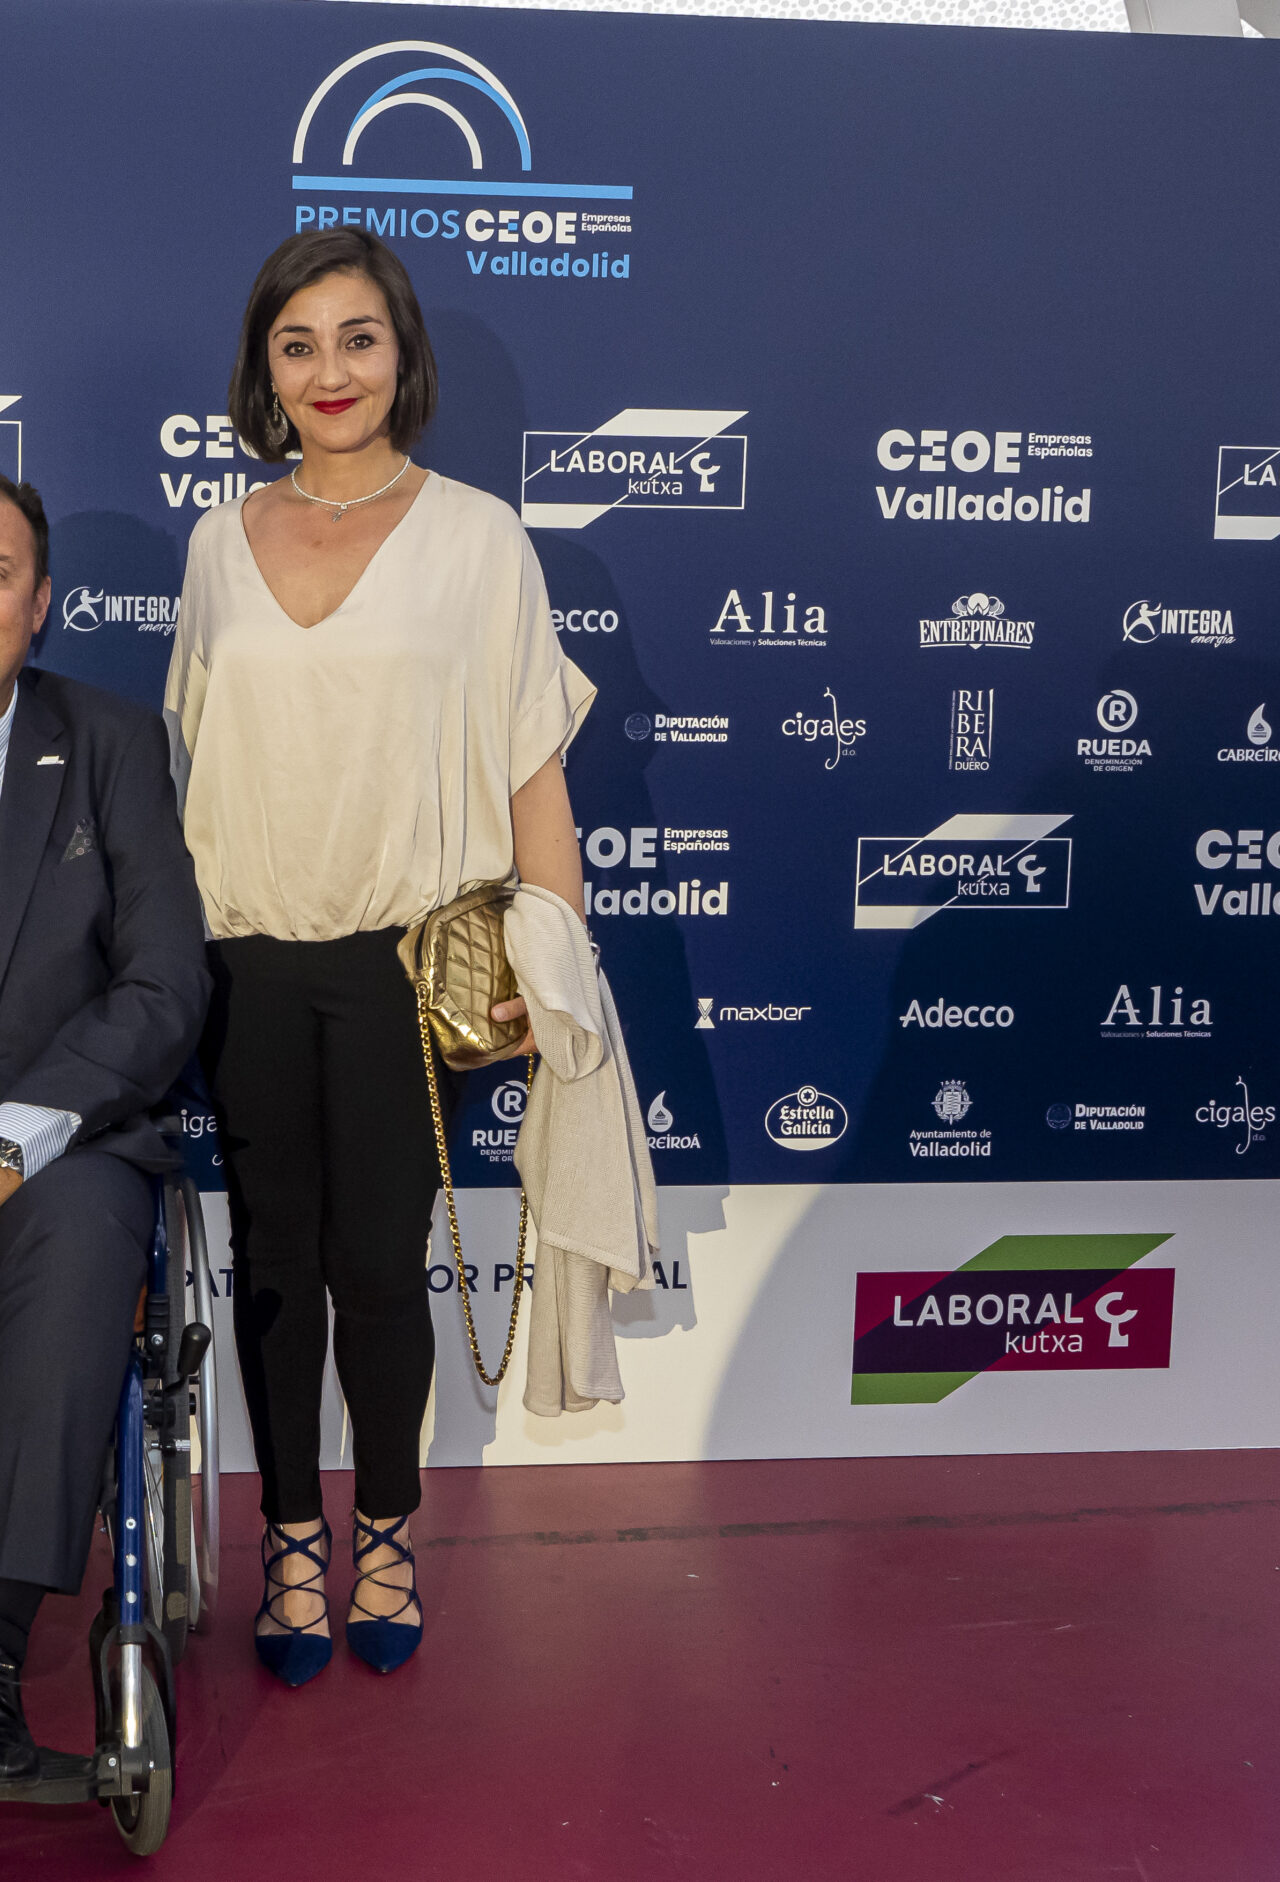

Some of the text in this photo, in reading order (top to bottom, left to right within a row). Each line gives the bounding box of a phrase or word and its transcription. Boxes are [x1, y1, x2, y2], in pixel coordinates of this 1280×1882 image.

[295, 206, 576, 244] PREMIOS CEOE
[581, 213, 631, 225] Empresas
[581, 222, 632, 233] Españolas
[466, 250, 631, 279] Valladolid
[1029, 433, 1091, 447] Empresas
[877, 429, 1022, 473] CEOE
[1028, 445, 1092, 459] Españolas
[549, 450, 683, 476] LABORAL
[628, 477, 683, 496] kutxa
[876, 486, 1090, 522] Valladolid
[710, 590, 828, 633] Alia
[552, 609, 618, 632] ecco
[1161, 609, 1234, 635] INTEGRA
[919, 619, 1036, 645] ENTREPINARES
[758, 638, 796, 646] Soluciones
[797, 638, 827, 647] Técnicas
[1078, 739, 1152, 755] RUEDA
[955, 762, 989, 770] DUERO
[1085, 758, 1144, 766] DENOMINACIÓN
[664, 827, 729, 842] Empresas
[663, 840, 730, 854] Españolas
[882, 854, 1010, 877] LABORAL
[958, 880, 1010, 896] kutxa
[583, 878, 729, 916] ladolid
[720, 1004, 811, 1020] maxber
[900, 998, 1014, 1027] Adecco
[1101, 985, 1213, 1025] Alia
[779, 1105, 834, 1120] Estrella
[780, 1120, 831, 1135] Galicia
[909, 1129, 992, 1140] Ayuntamiento de
[909, 1141, 991, 1157] Valladolid
[893, 1293, 1084, 1327] LABORAL
[1005, 1331, 1083, 1354] kutxa
